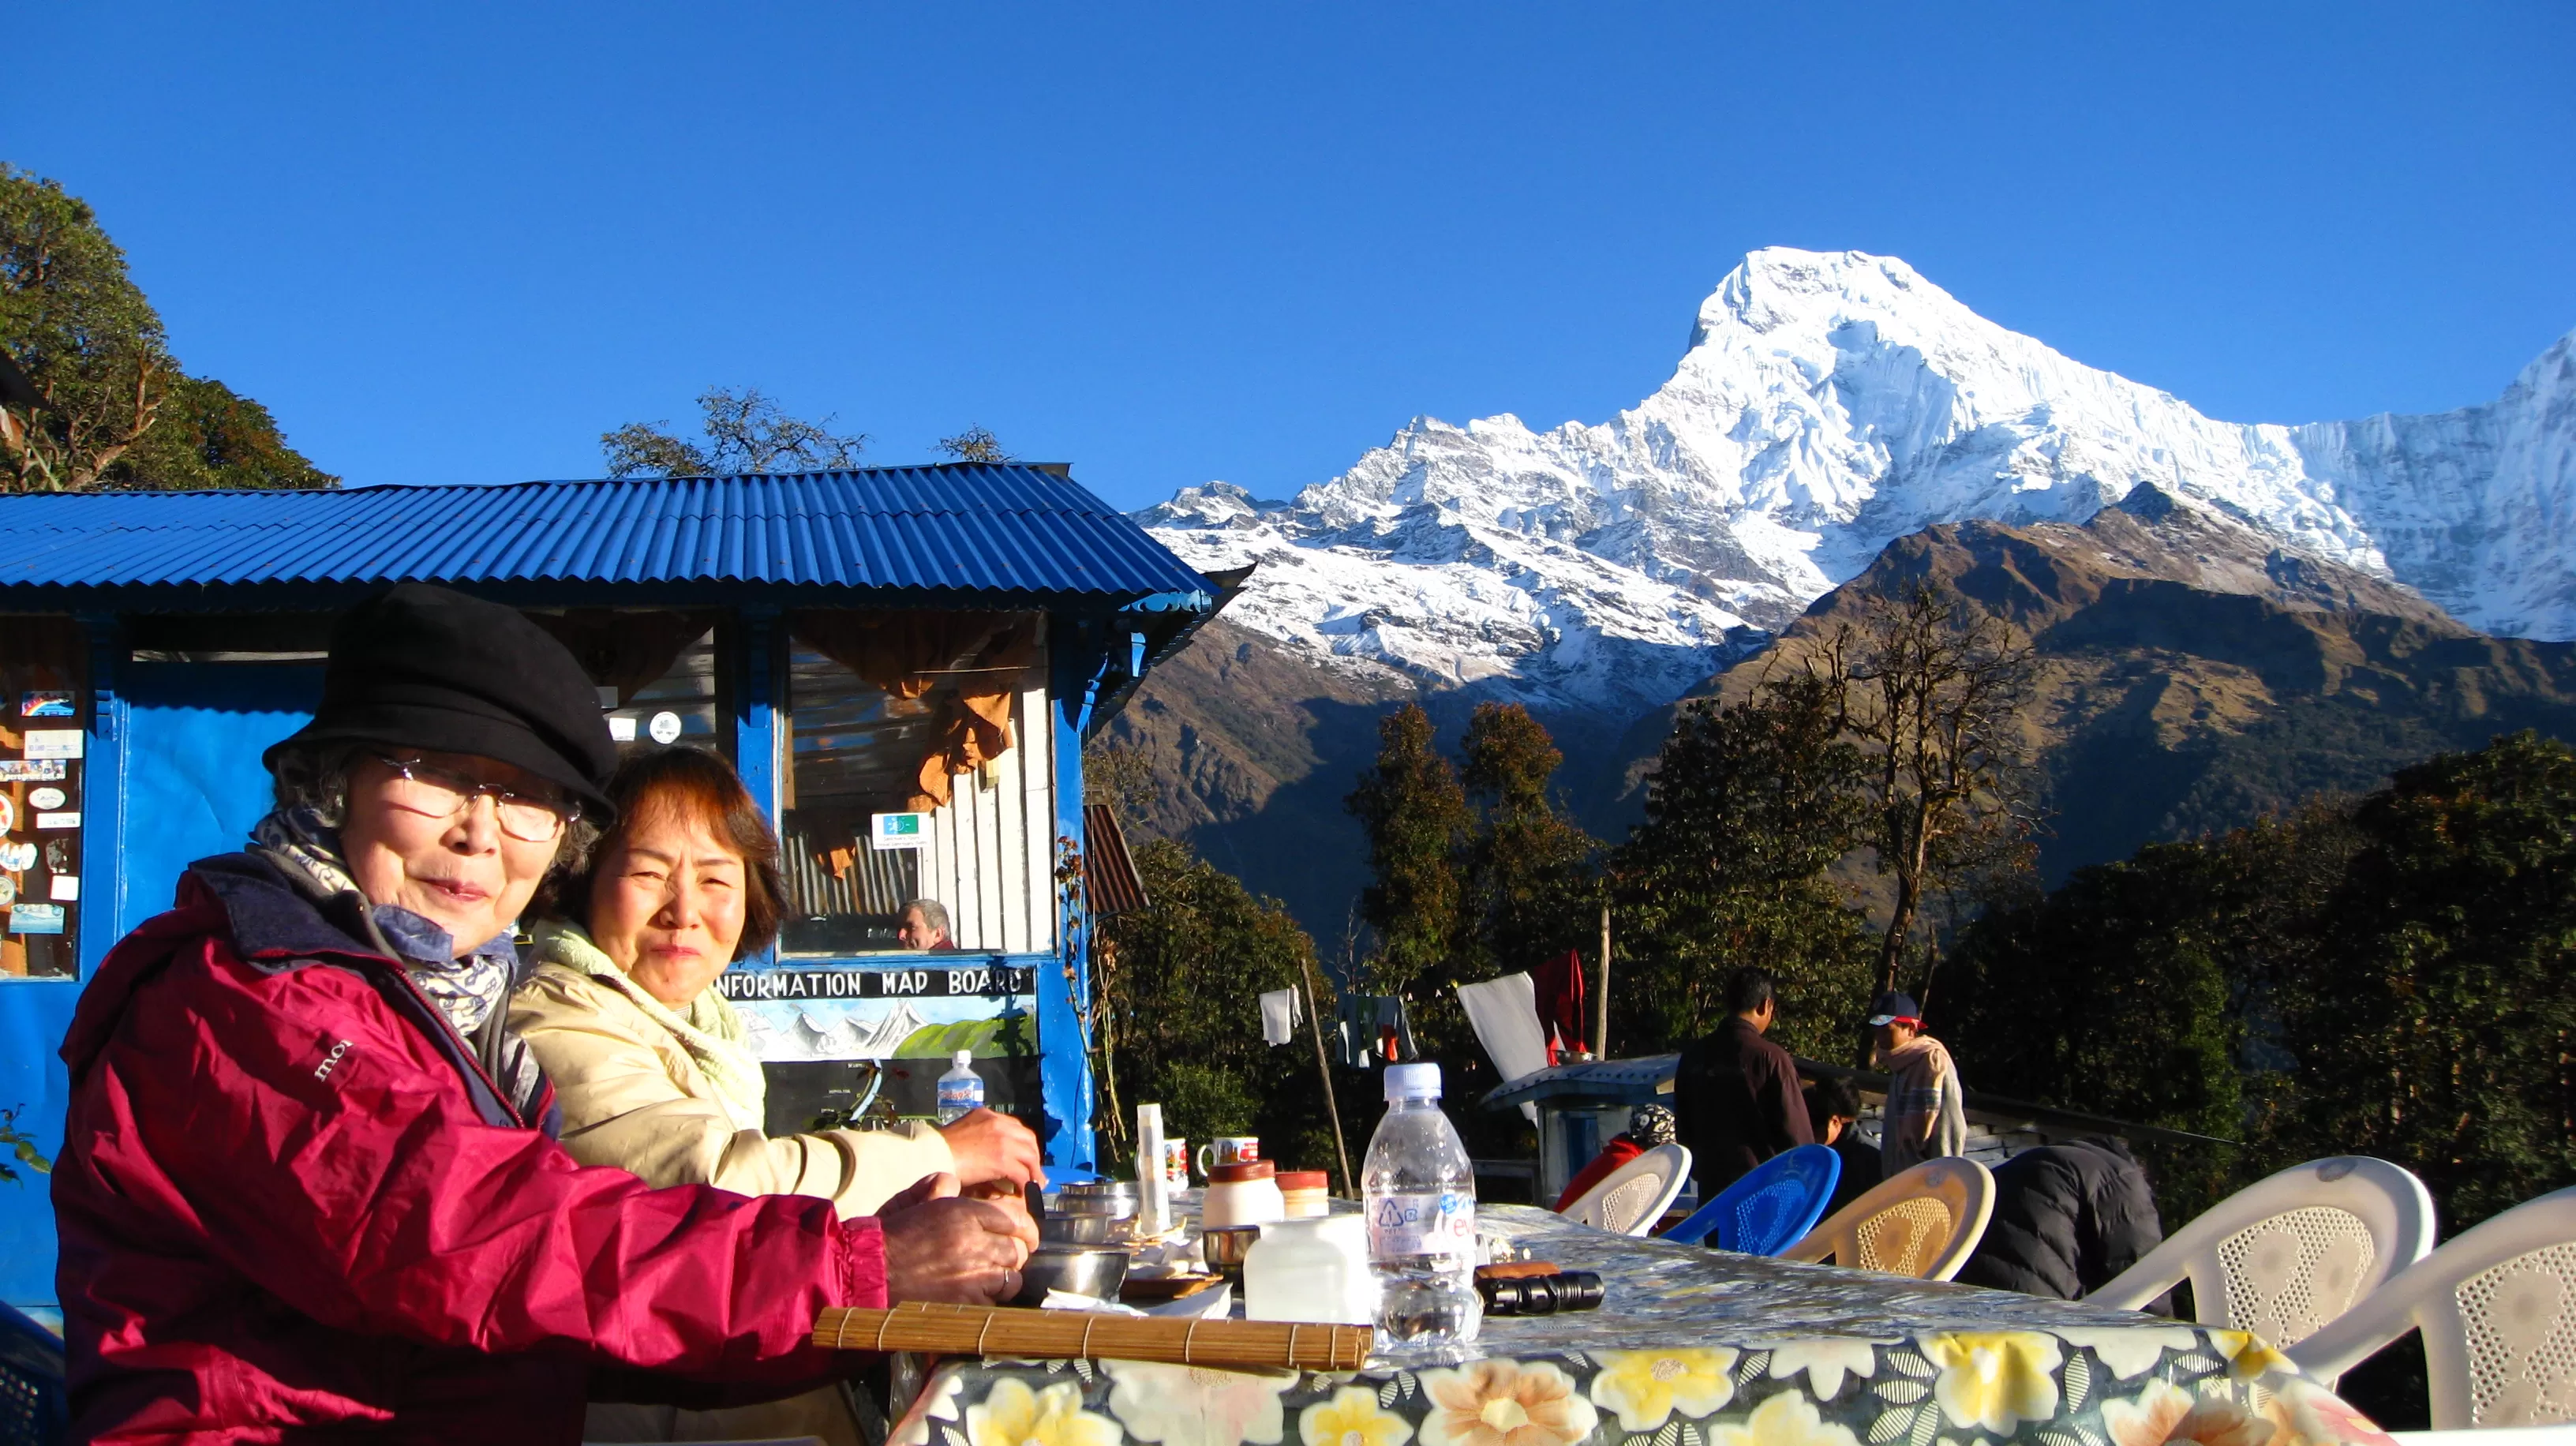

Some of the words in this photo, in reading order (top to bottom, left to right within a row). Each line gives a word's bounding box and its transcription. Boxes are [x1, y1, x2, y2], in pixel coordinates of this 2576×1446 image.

[715, 972, 861, 1000] NFORMATION
[882, 970, 929, 995] MAP
[948, 968, 1022, 995] BOARD
